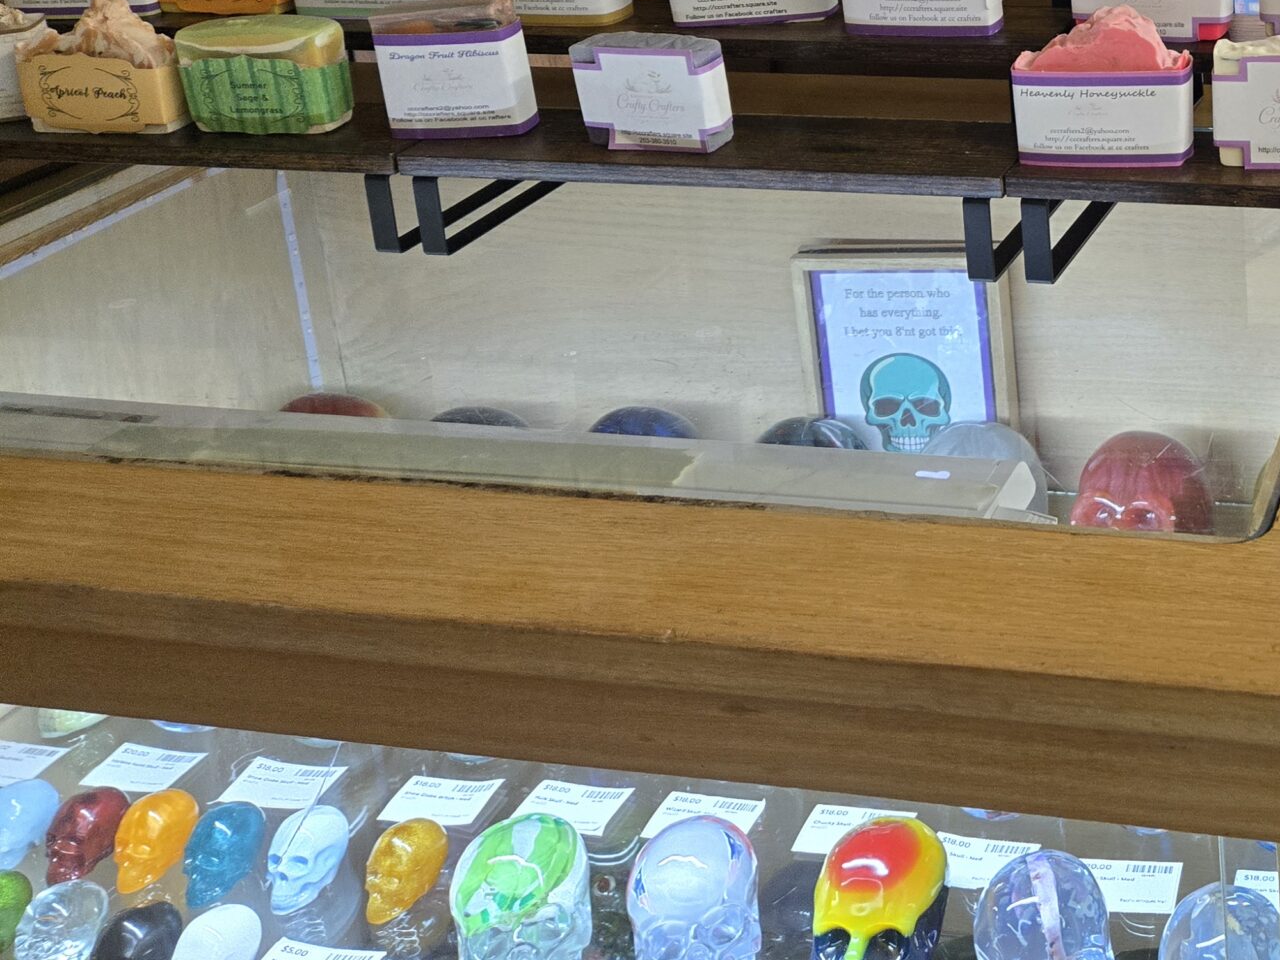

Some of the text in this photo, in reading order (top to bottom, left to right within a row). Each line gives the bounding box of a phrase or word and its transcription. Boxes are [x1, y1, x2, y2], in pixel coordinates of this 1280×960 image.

[389, 49, 500, 62] Dragon Fruit Hibiscus
[230, 81, 267, 90] Summer
[235, 93, 260, 104] Sage
[1020, 88, 1158, 100] Heavenly Honeysuckle
[229, 106, 284, 116] Lemongrass
[844, 288, 951, 302] For the person who
[859, 306, 943, 320] has everything.
[872, 329, 893, 340] you
[918, 328, 937, 339] got
[256, 762, 285, 773] $18.00
[412, 779, 441, 789] $18.00
[542, 783, 571, 794] $18.00
[672, 794, 702, 805] $18.00
[818, 808, 849, 817] $18.00
[942, 836, 971, 849] $18.00
[1243, 874, 1275, 883] $18.00
[280, 945, 309, 957] $5.00
